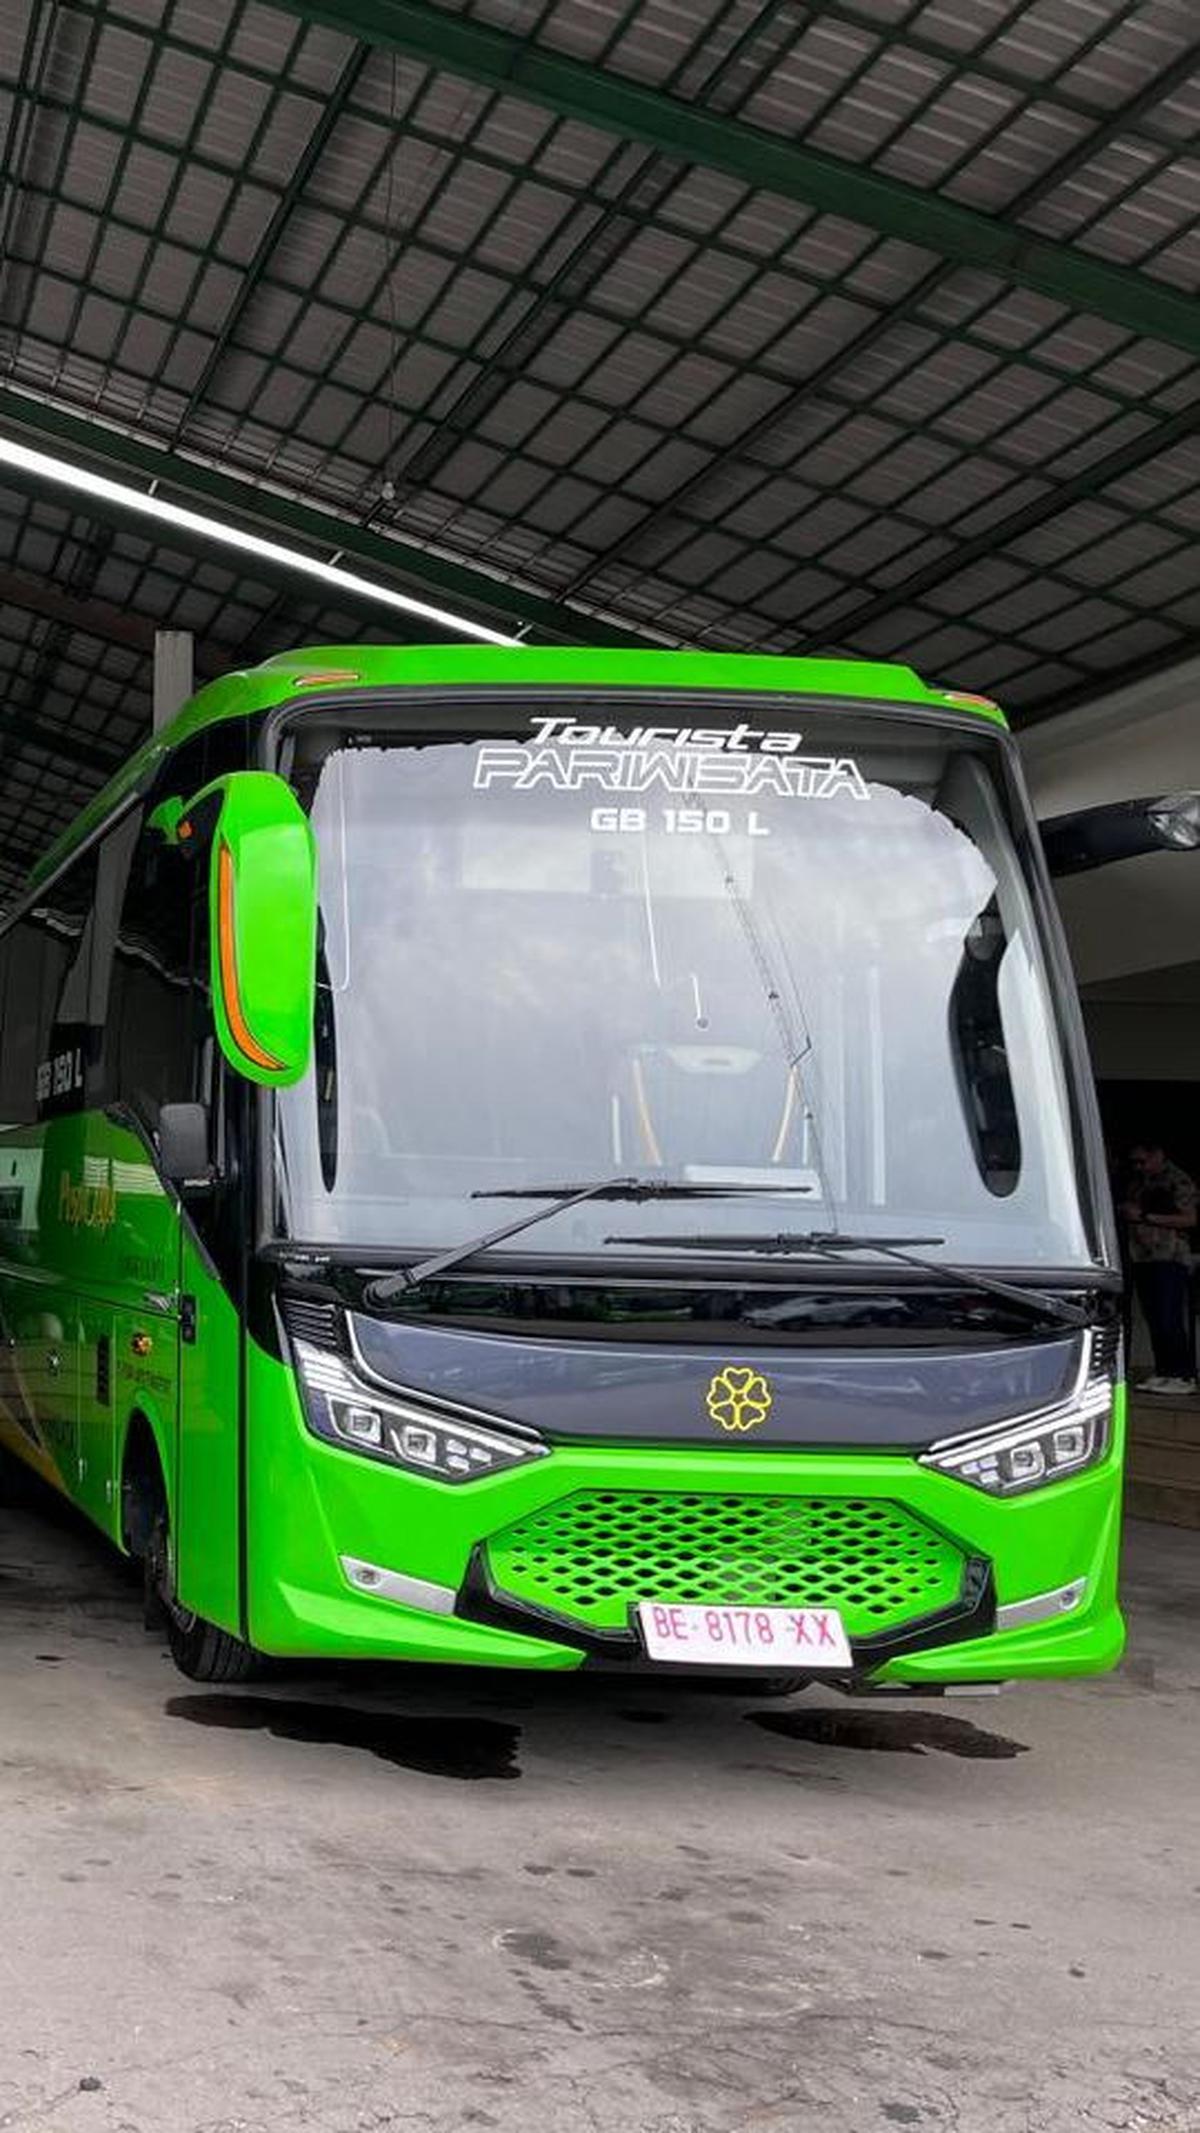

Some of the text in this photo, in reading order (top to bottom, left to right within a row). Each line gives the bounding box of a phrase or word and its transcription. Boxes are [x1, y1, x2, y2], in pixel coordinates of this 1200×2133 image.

[529, 717, 802, 752] Tourista
[473, 748, 871, 800] PARIWISATA
[589, 808, 771, 836] GB 150 L
[73, 1048, 83, 1087] L
[652, 1606, 837, 1647] BE 8178 XX
